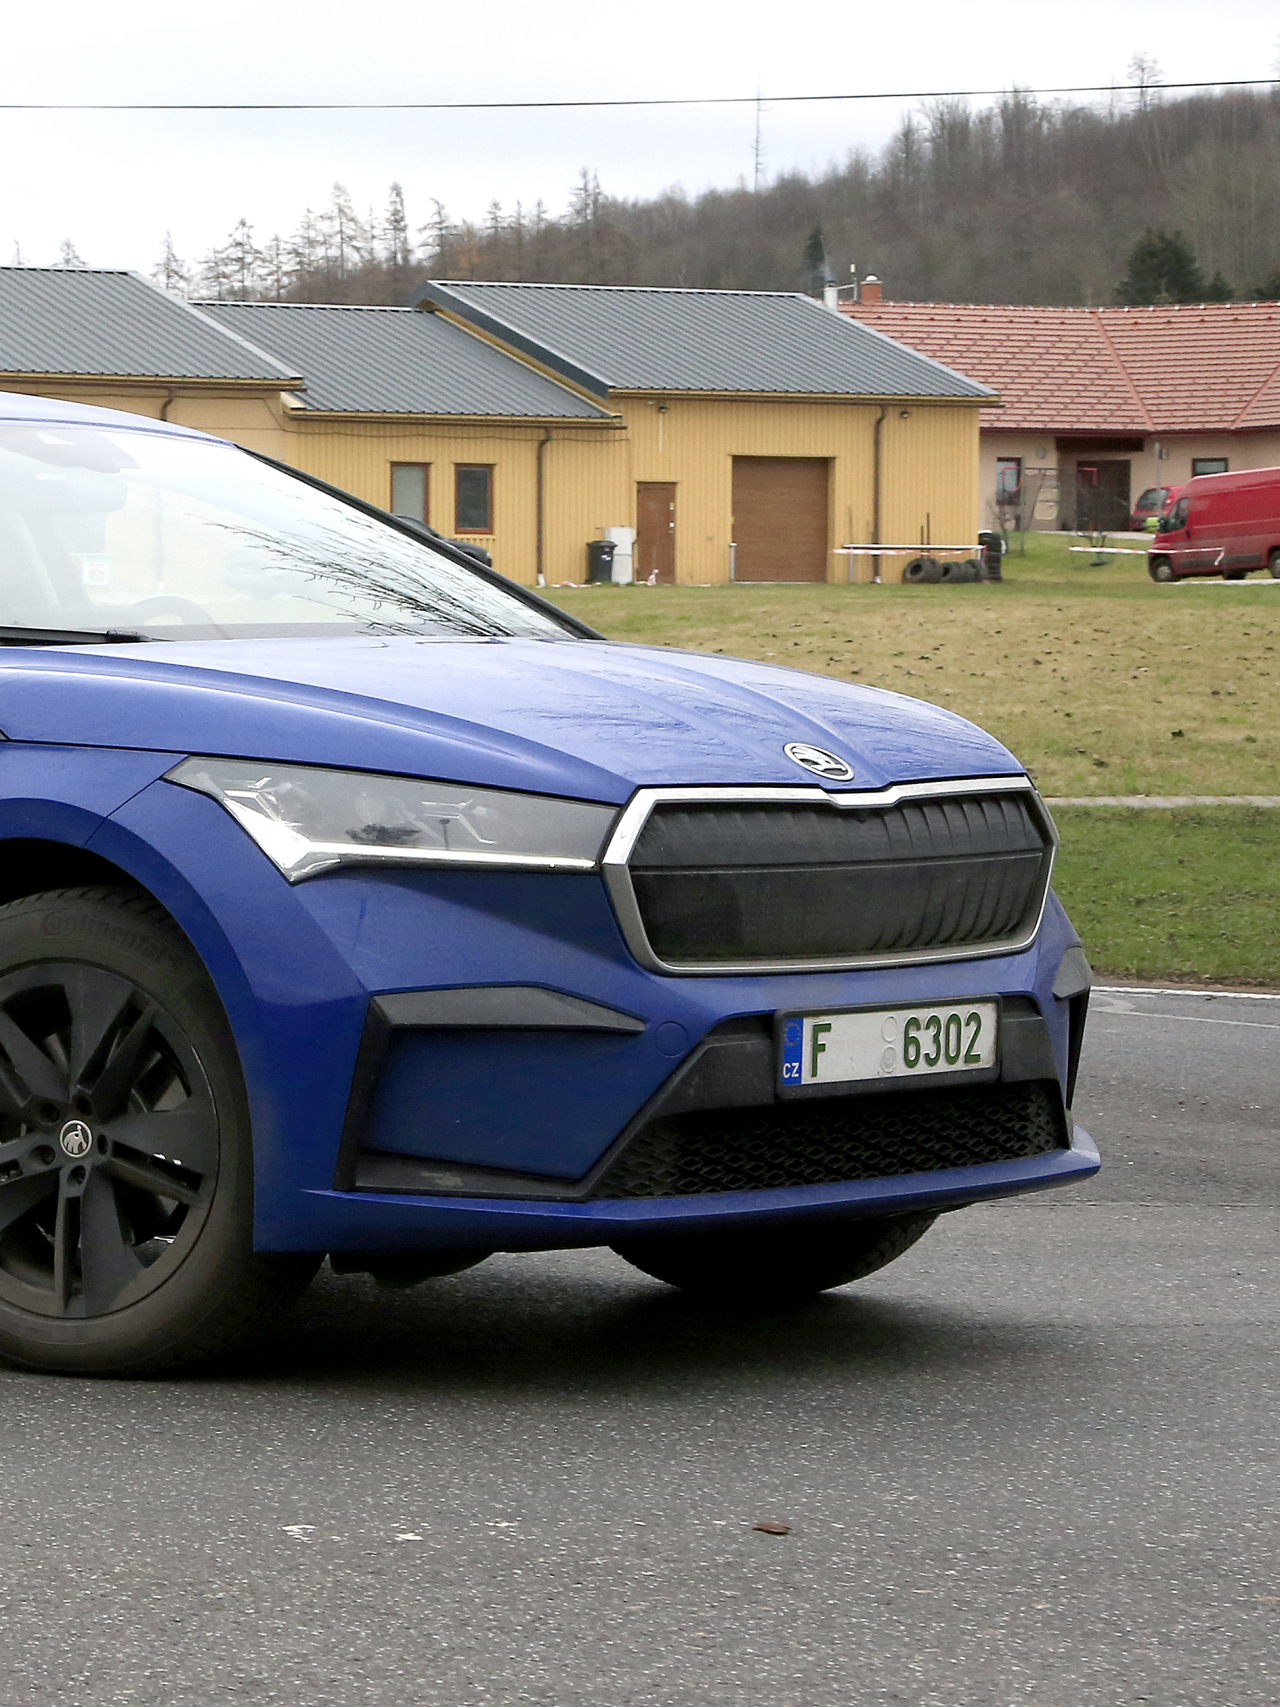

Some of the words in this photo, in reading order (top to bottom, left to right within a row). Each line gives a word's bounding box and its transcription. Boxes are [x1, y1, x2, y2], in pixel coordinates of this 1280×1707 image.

[811, 1022, 832, 1078] F
[903, 1011, 982, 1069] 6302
[782, 1062, 800, 1079] CZ
